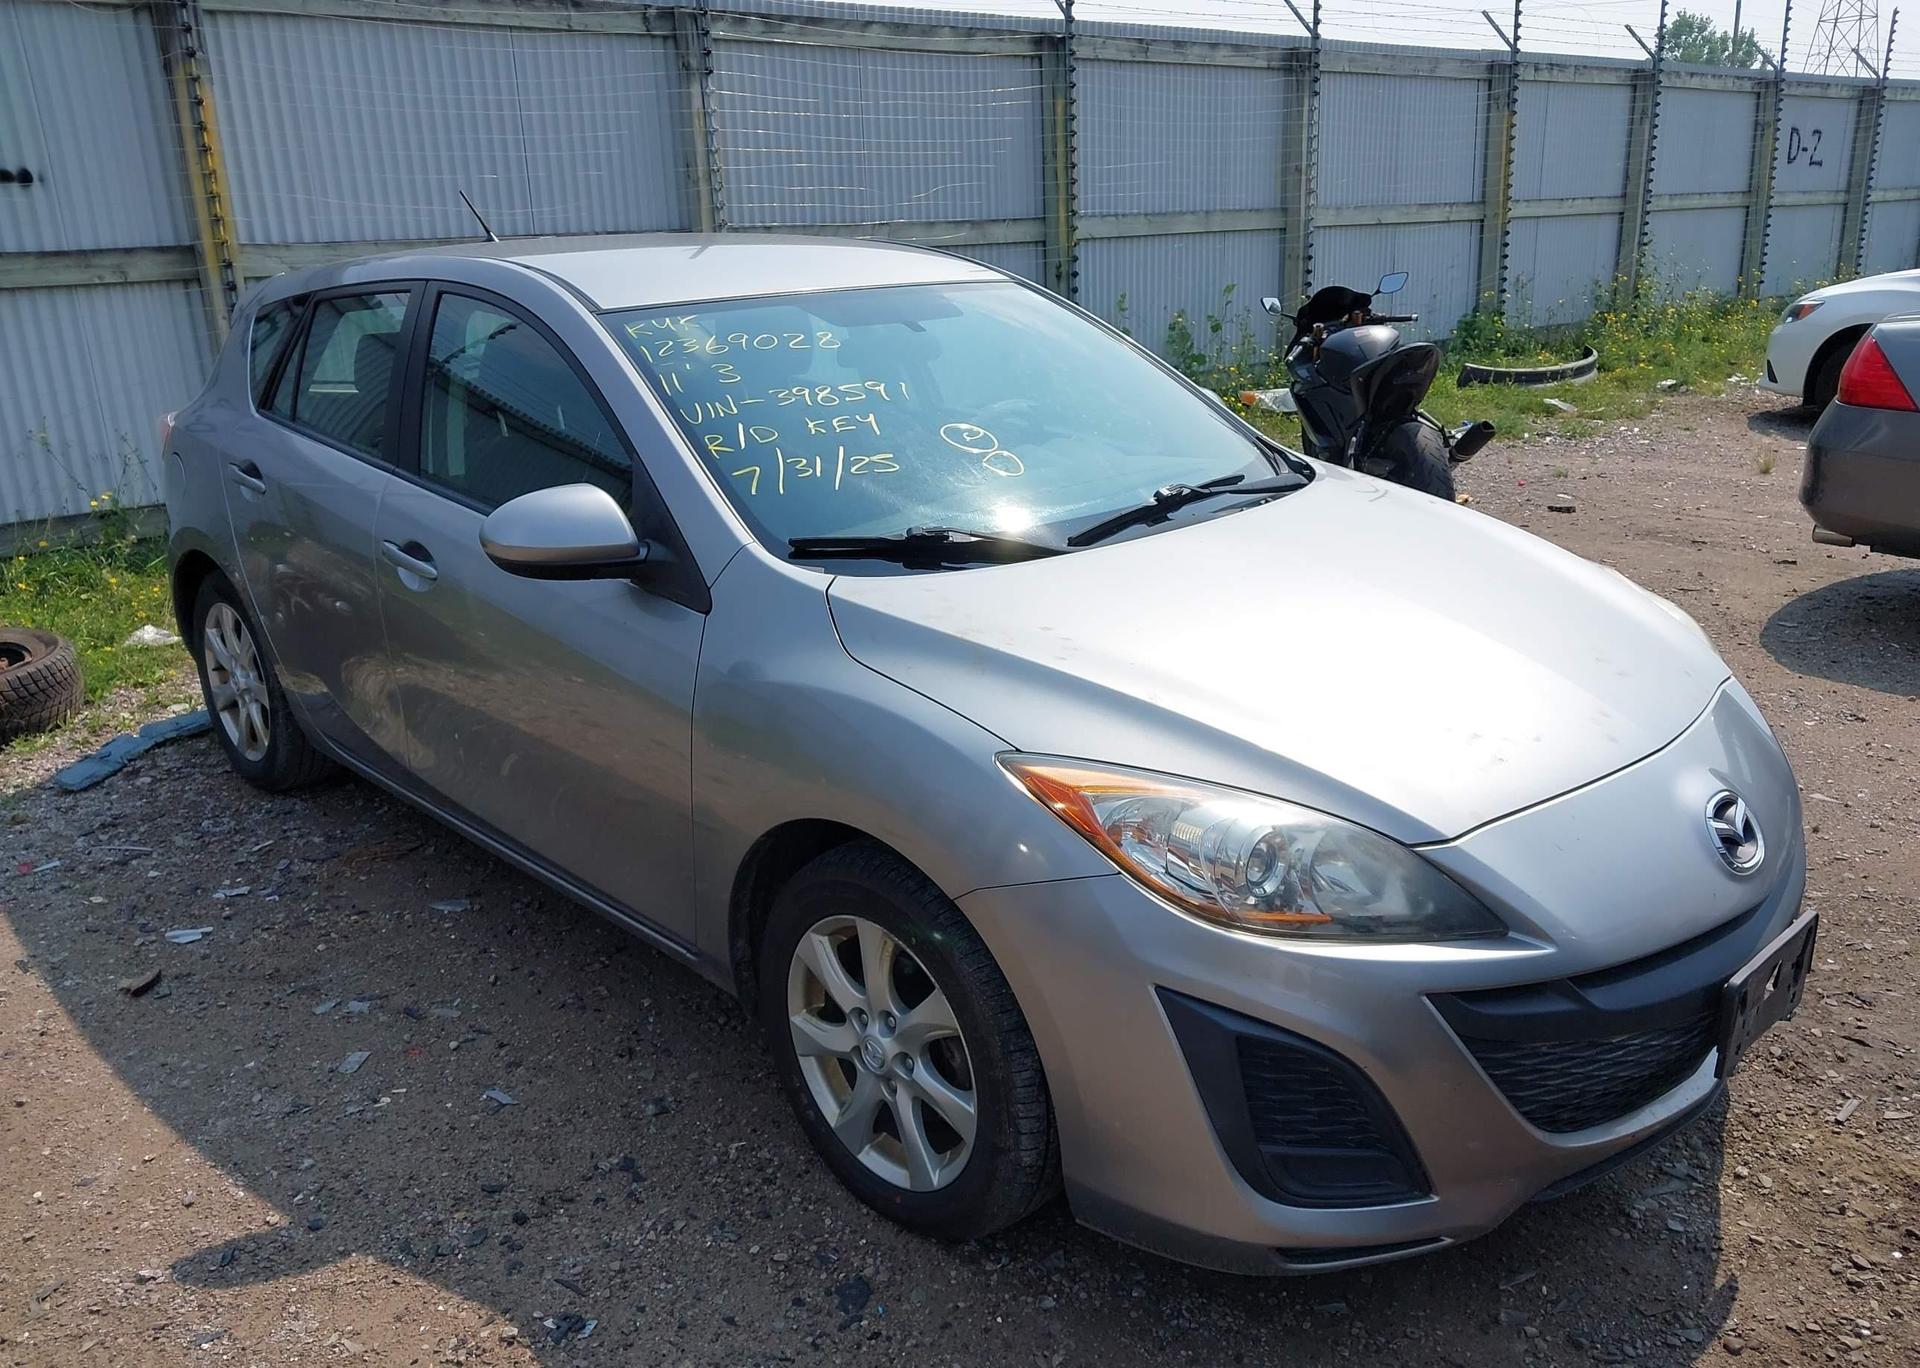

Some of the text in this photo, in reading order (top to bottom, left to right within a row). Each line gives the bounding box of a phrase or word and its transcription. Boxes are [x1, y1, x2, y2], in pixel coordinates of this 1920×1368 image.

[1786, 126, 1823, 167] D-2
[640, 332, 841, 363] 12369028
[804, 413, 881, 435] KEY
[731, 445, 900, 495] 7/31/25
